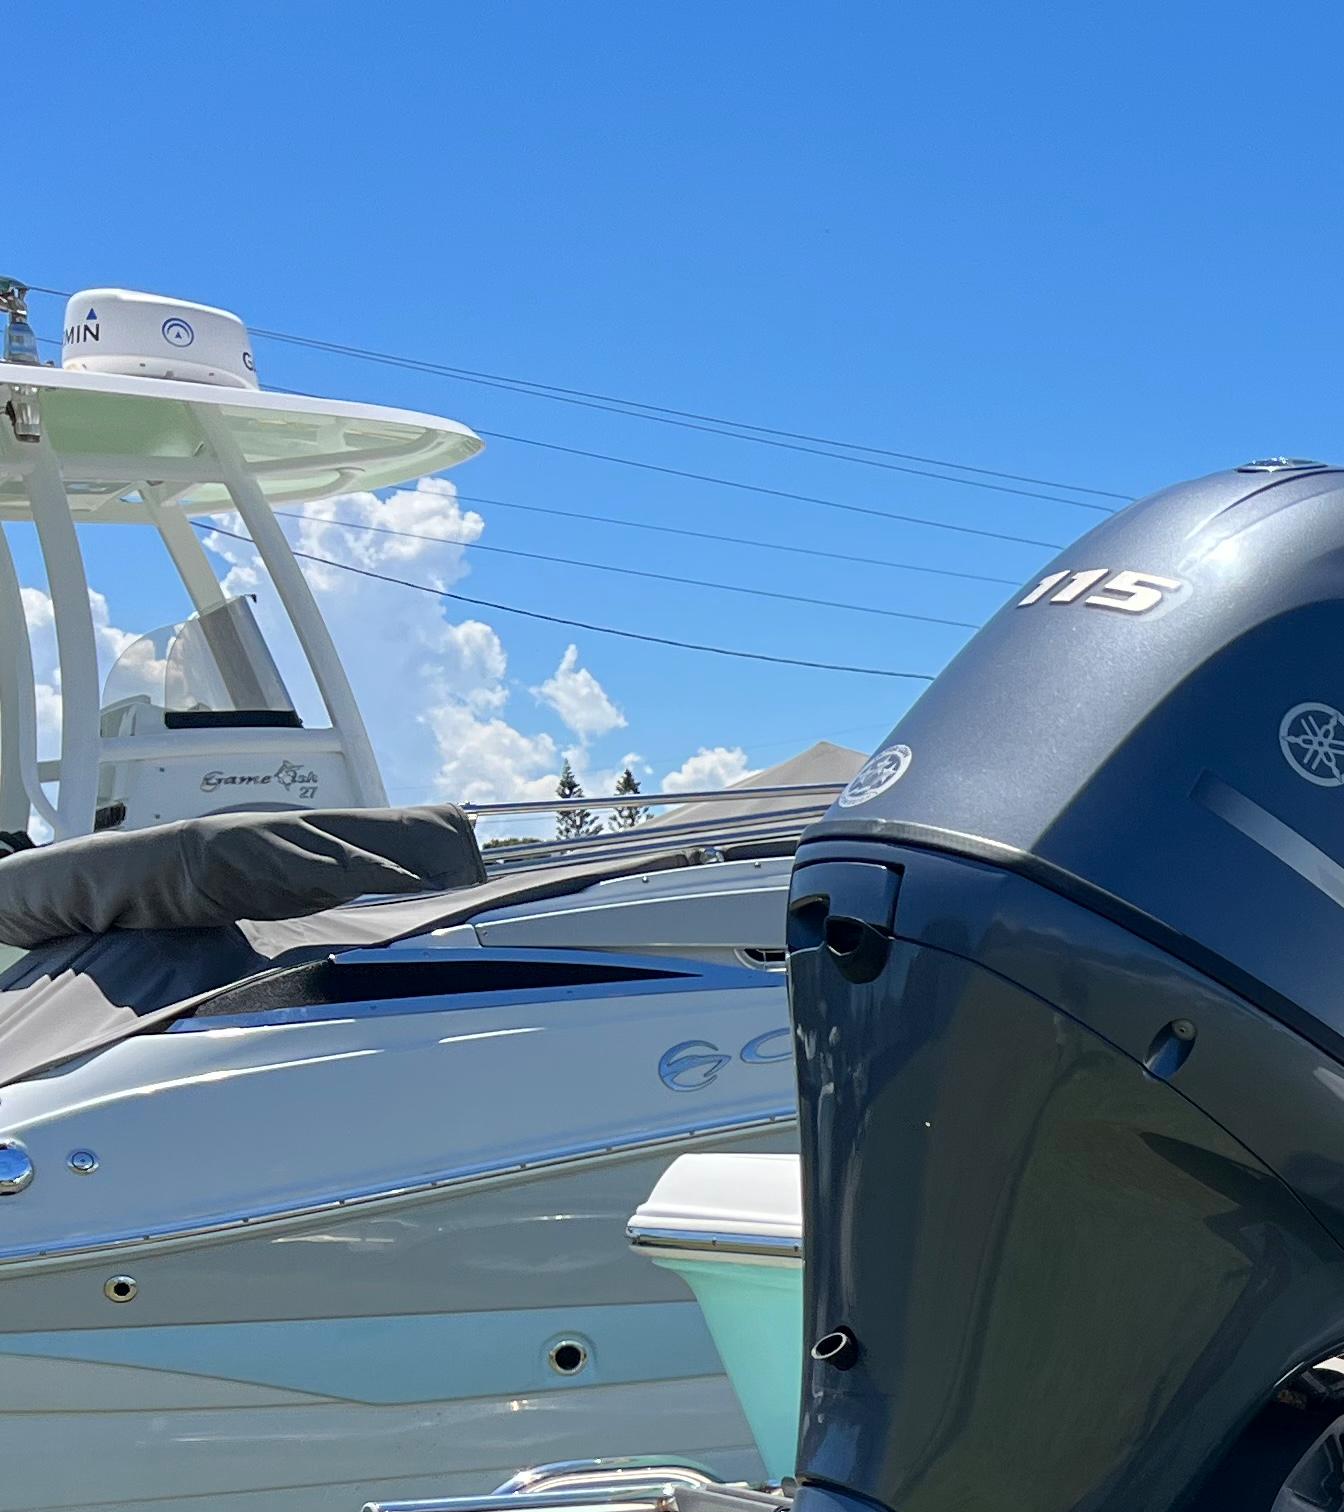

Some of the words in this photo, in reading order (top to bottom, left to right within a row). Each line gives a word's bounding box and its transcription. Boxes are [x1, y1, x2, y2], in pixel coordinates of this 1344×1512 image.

[64, 323, 100, 345] MIN
[1017, 568, 1183, 616] 115
[299, 786, 318, 799] 27
